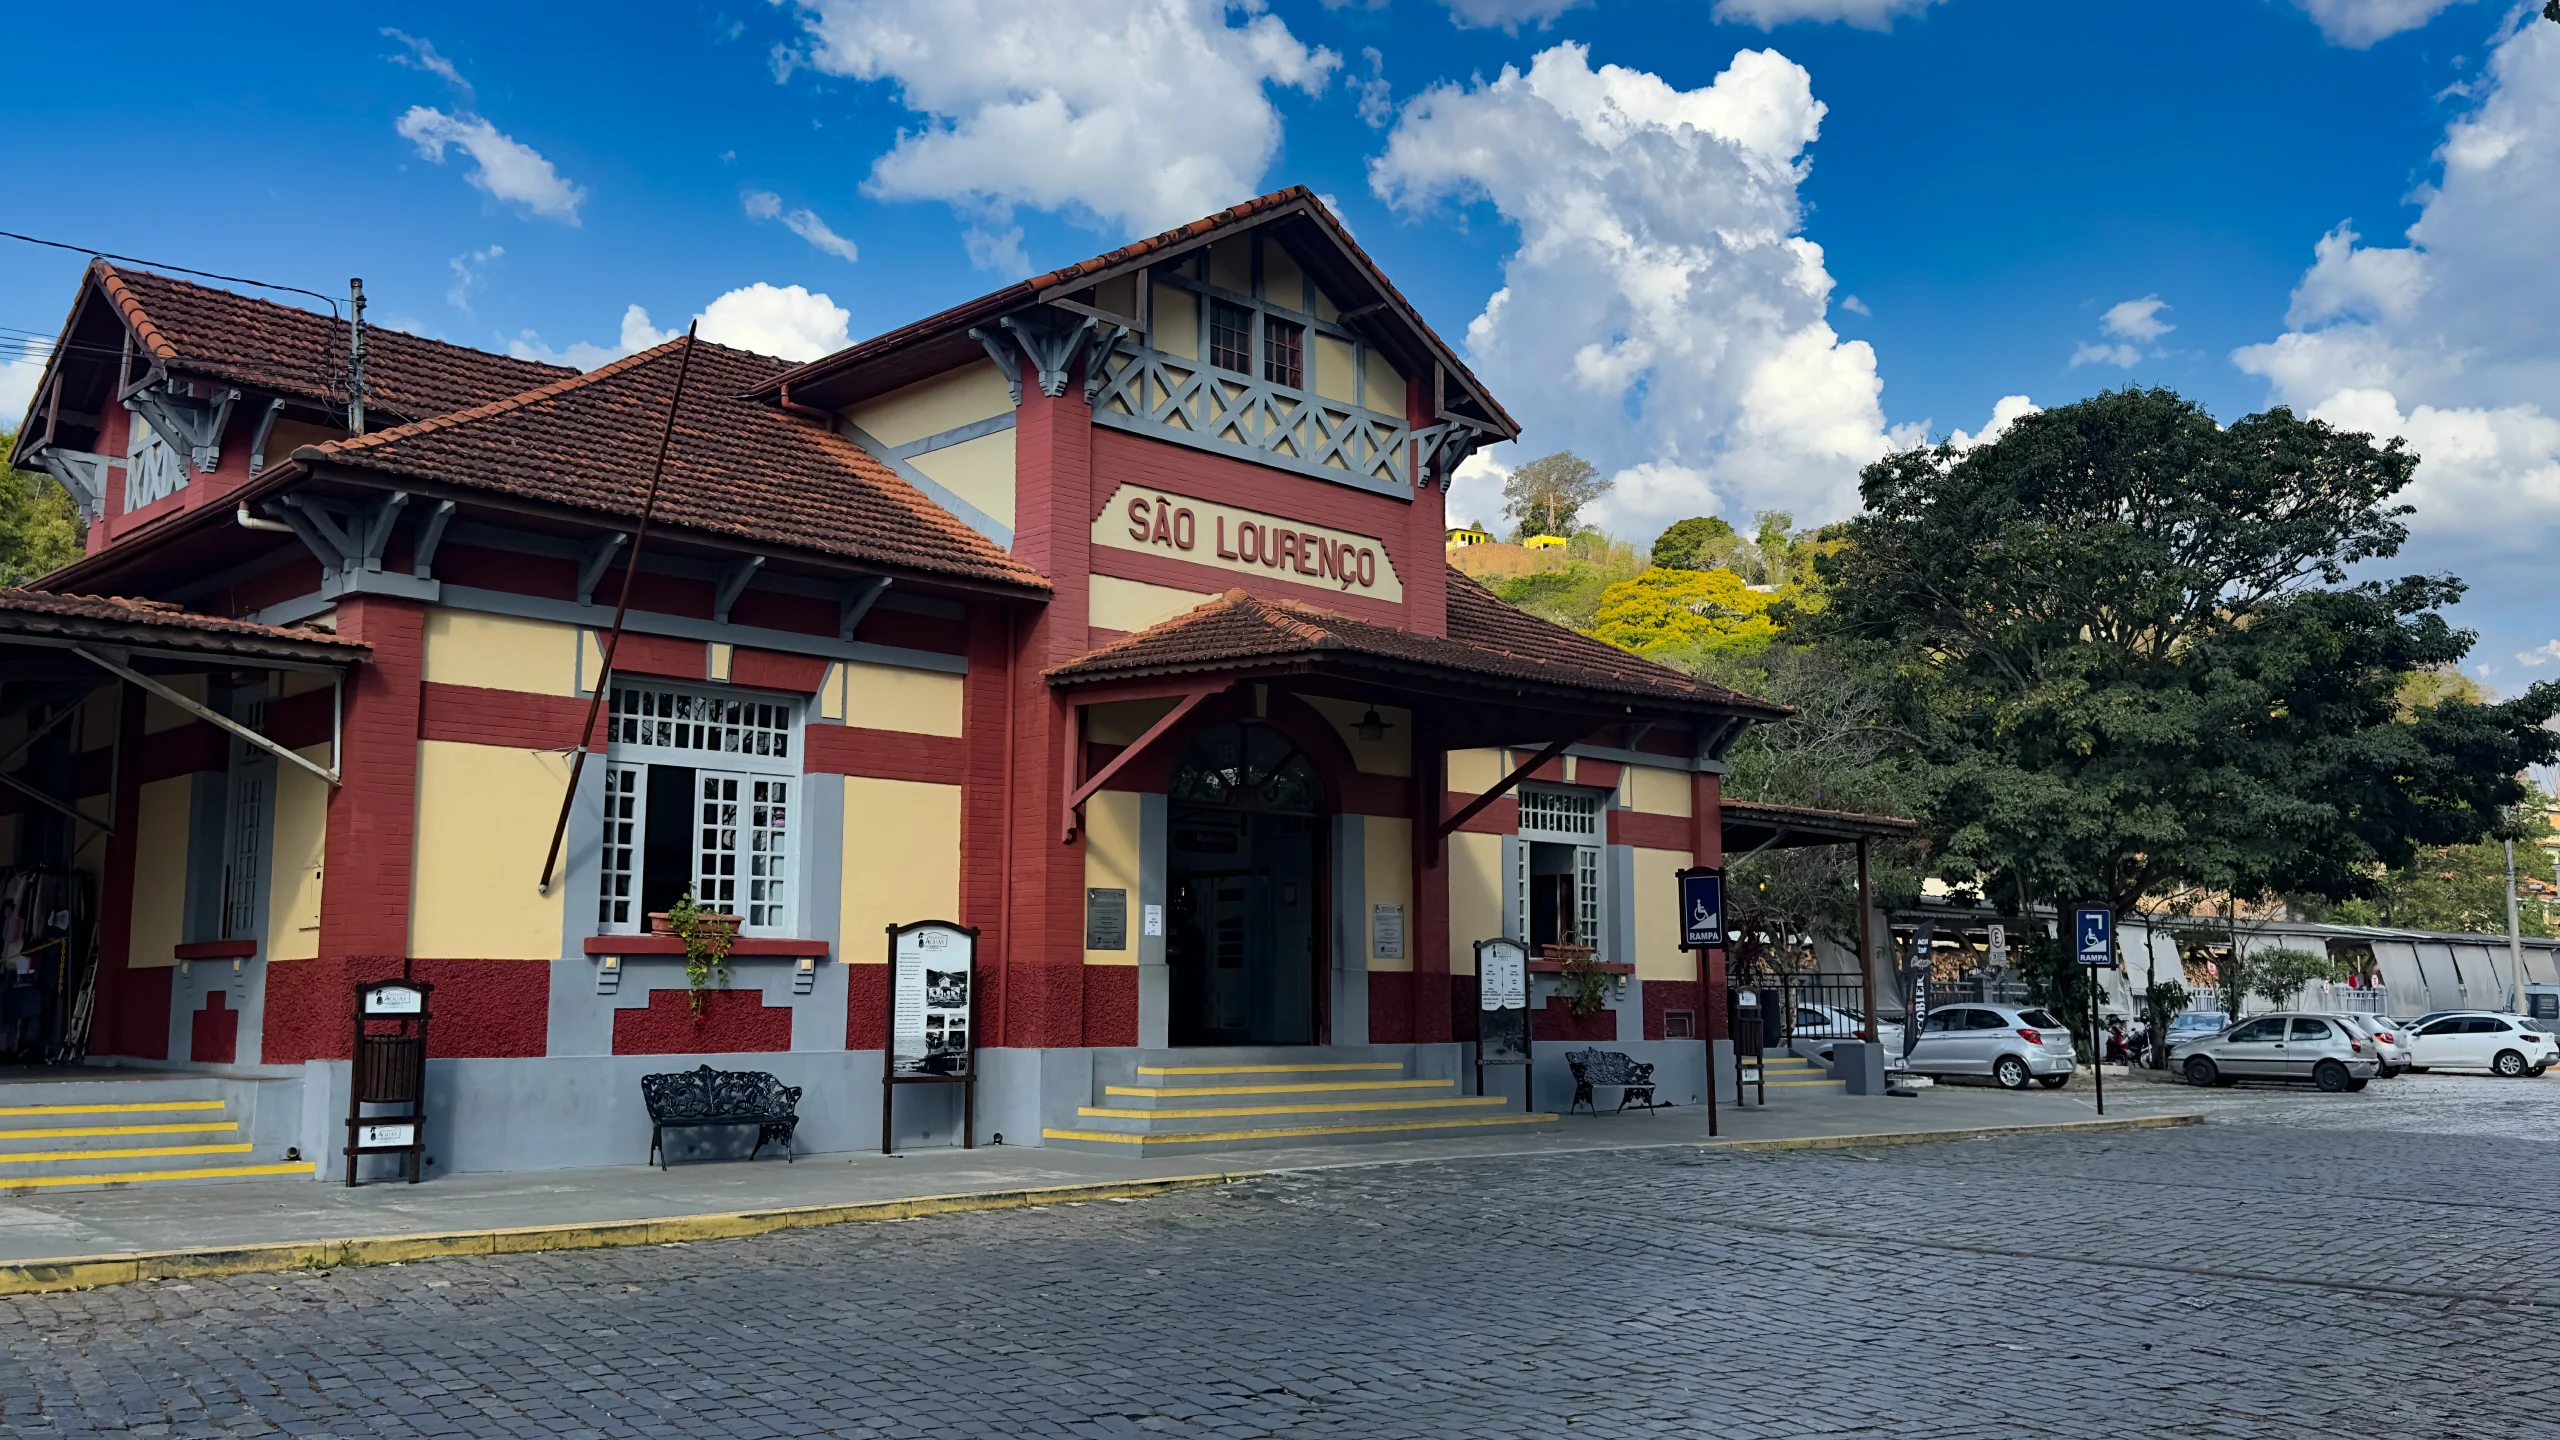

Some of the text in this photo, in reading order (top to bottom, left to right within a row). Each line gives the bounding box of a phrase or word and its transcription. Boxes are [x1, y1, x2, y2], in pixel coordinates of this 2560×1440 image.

[1128, 495, 1375, 590] SÃO LOURENÇO
[1690, 932, 1719, 940] RAMPA
[2080, 954, 2108, 962] RAMPA
